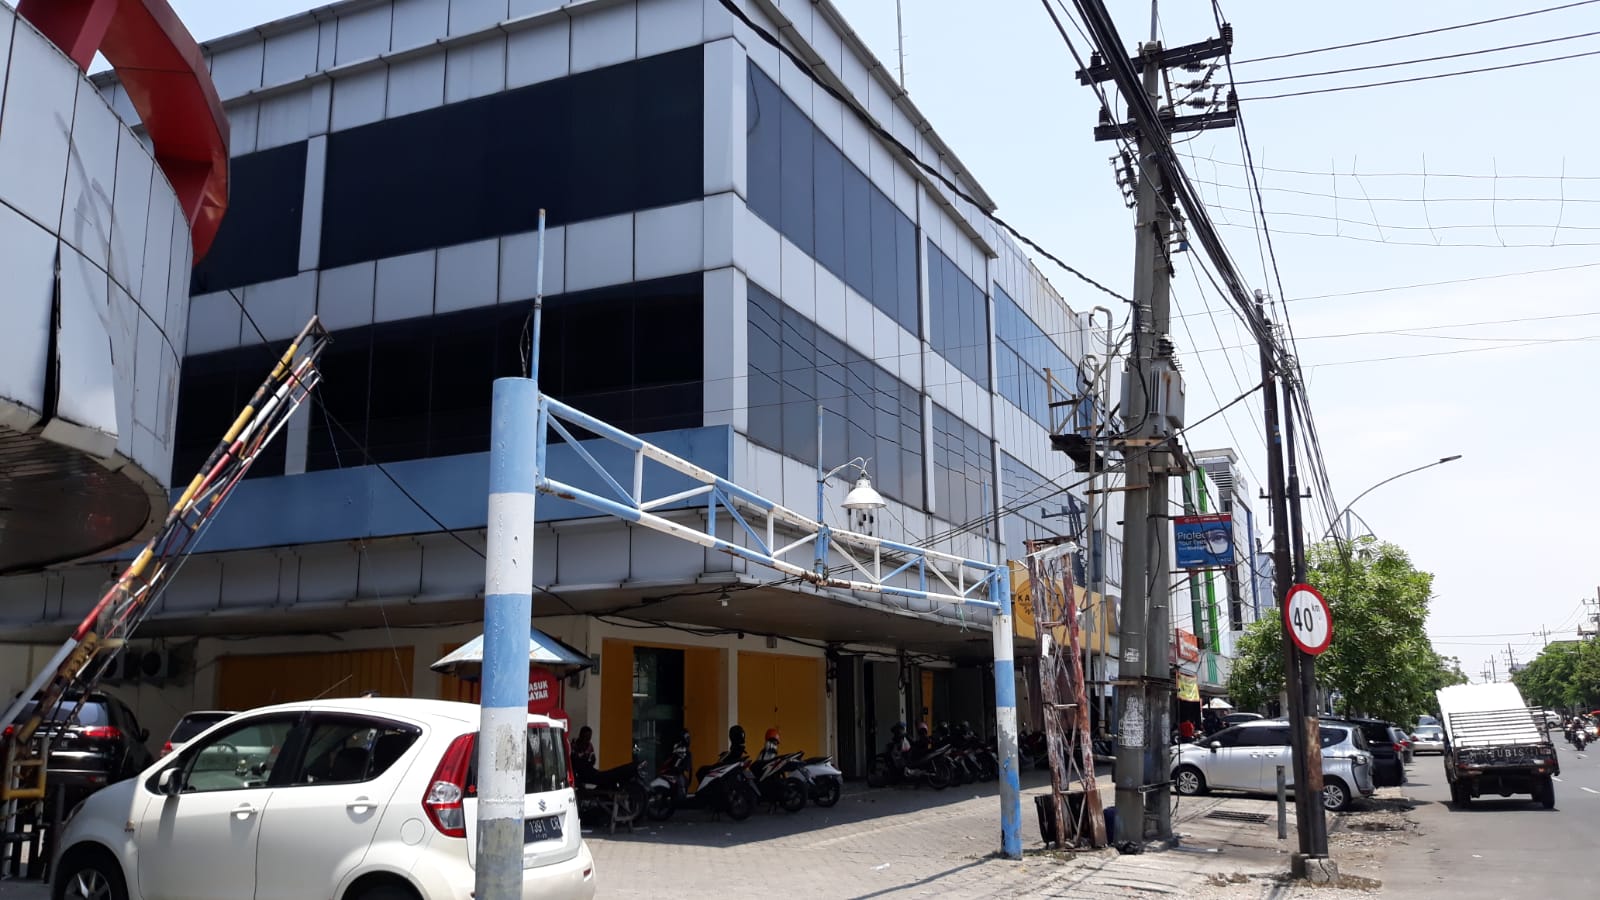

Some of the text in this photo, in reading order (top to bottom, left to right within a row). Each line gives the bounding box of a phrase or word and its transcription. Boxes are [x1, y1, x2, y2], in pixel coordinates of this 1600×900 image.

[1294, 606, 1313, 632] 40
[528, 680, 548, 692] ASUK
[528, 689, 548, 701] AYAR
